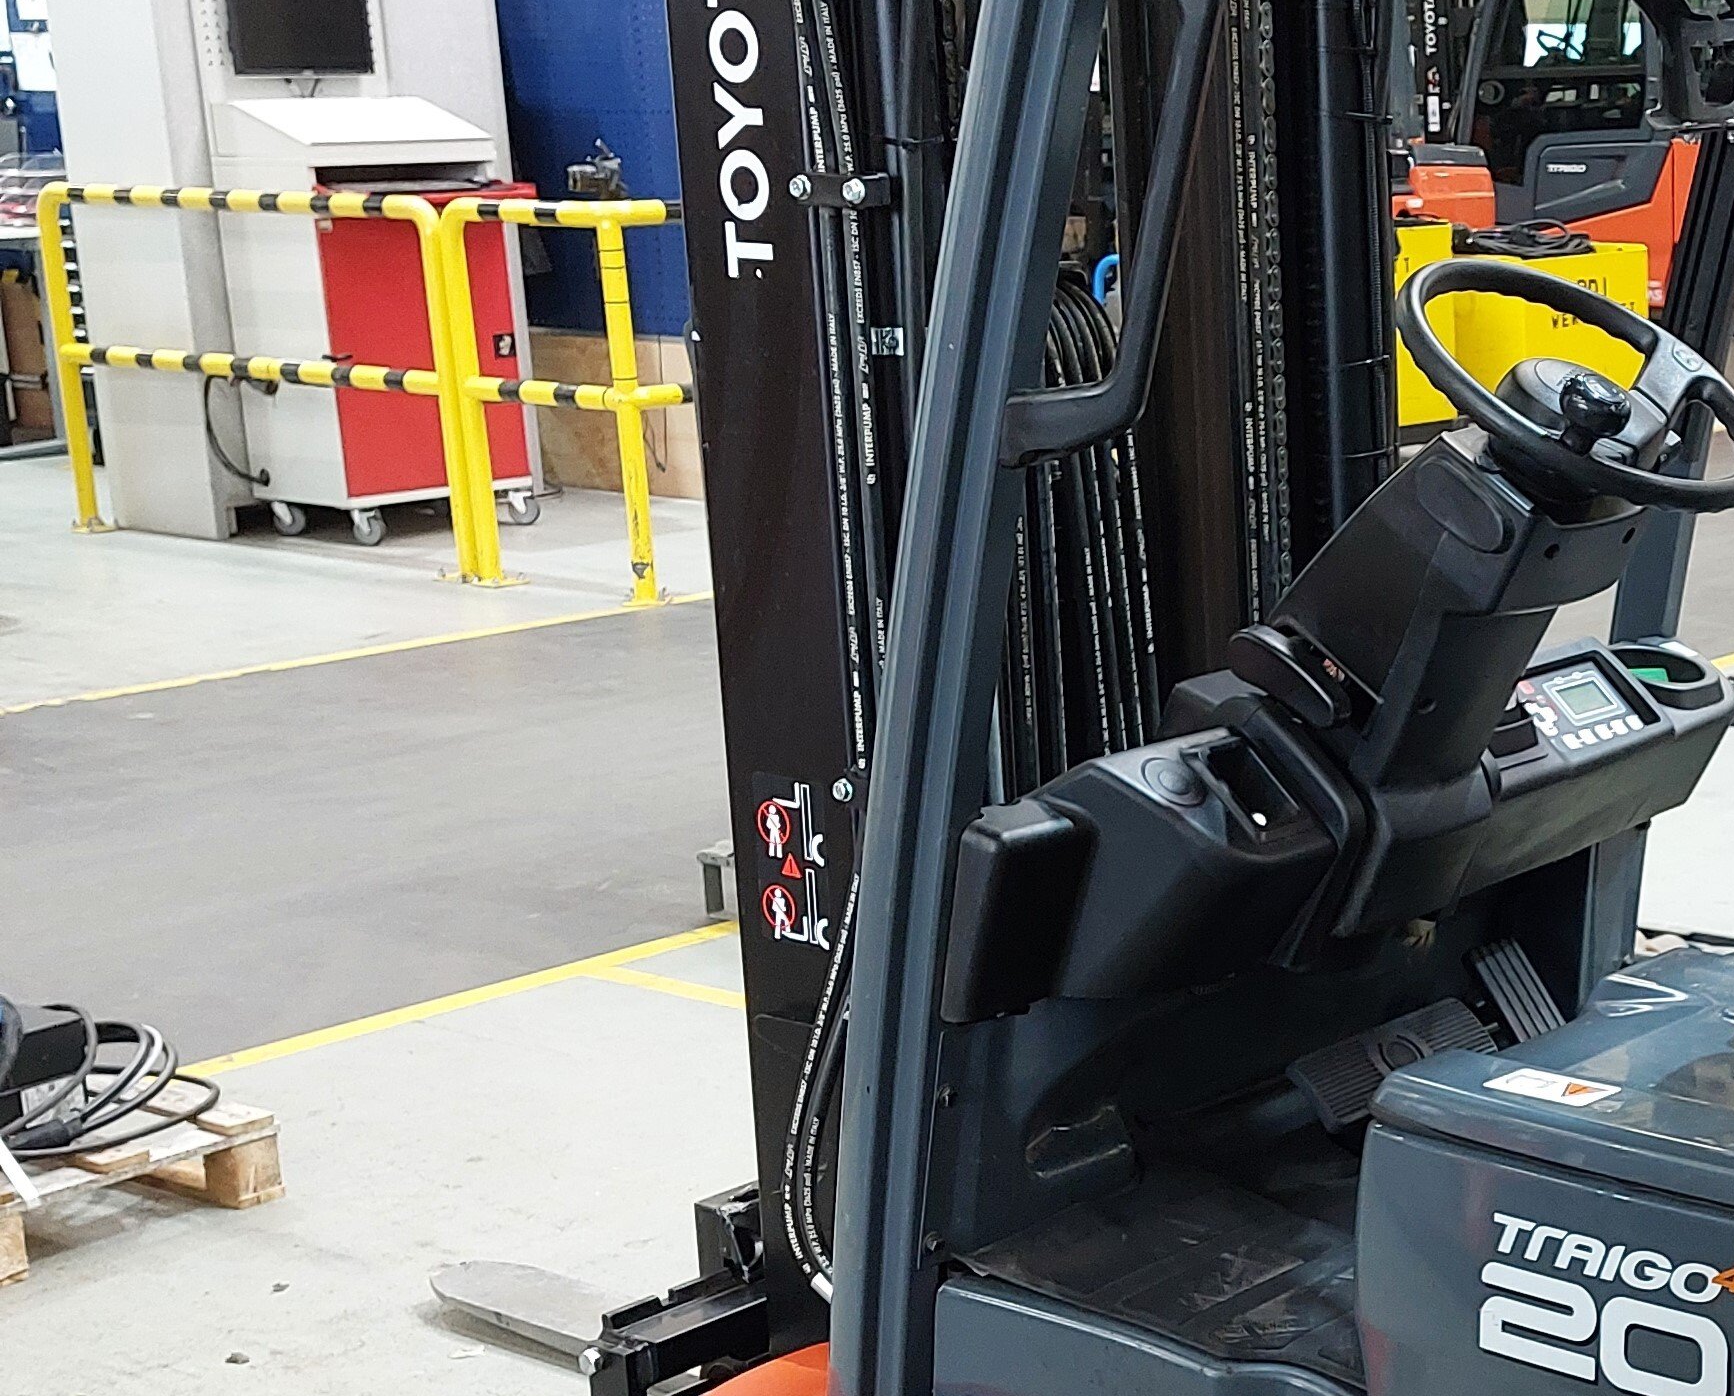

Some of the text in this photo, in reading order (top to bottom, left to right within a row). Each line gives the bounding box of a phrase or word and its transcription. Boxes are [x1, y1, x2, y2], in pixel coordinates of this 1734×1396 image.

[810, 107, 825, 173] INTERPUMP
[826, 314, 837, 335] ITALY
[828, 336, 838, 345] IN
[828, 347, 840, 372] MADE
[862, 403, 875, 467] INTERPUMP
[874, 597, 887, 653] MADE IN ITALY
[853, 691, 865, 752] INTERPUMP
[784, 1203, 803, 1259] INTERPUMP
